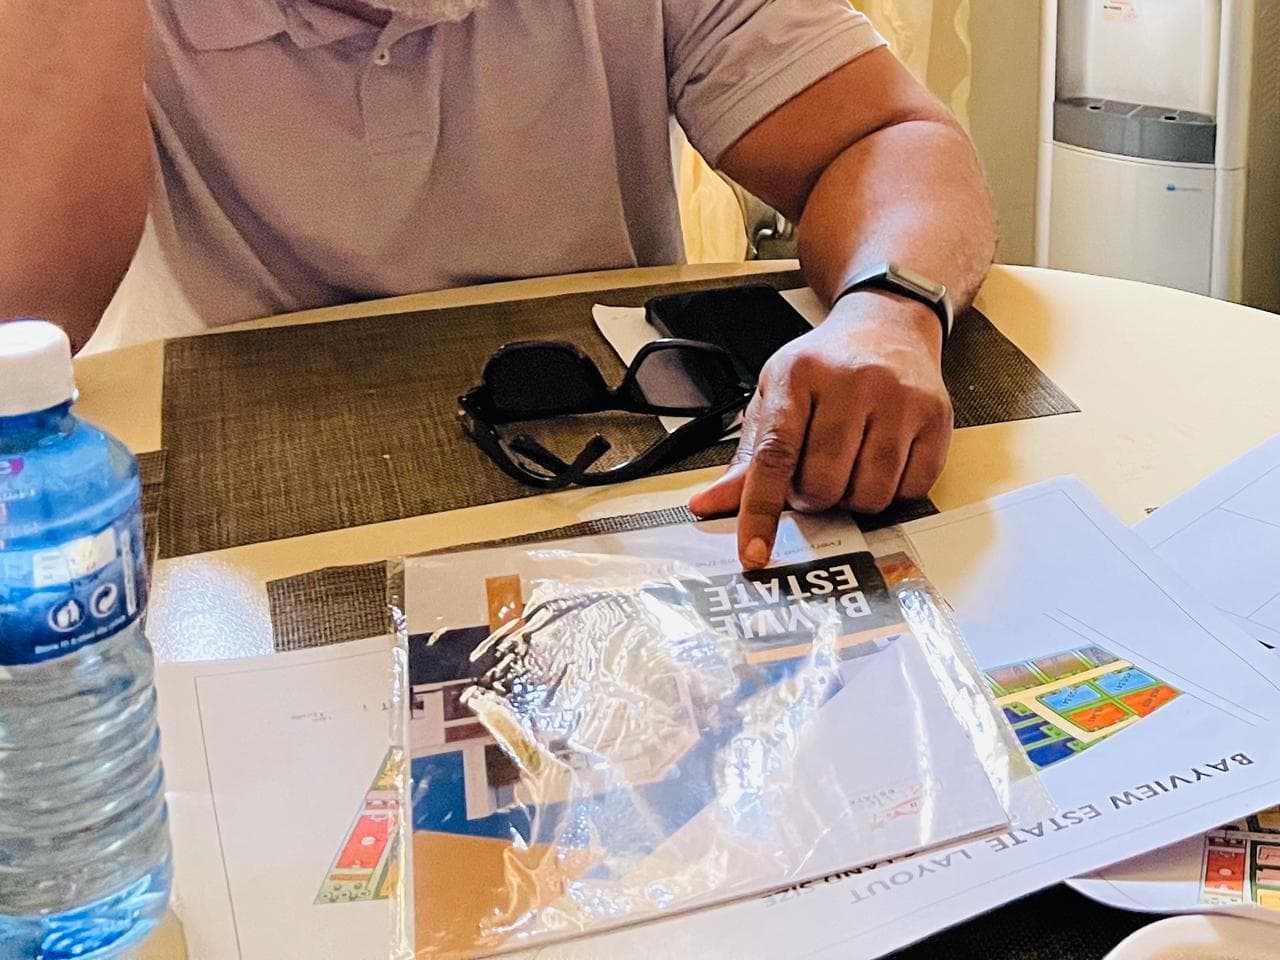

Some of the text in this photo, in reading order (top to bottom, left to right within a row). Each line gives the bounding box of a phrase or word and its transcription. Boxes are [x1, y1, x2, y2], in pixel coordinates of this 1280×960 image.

[703, 564, 860, 613] ESTATE
[849, 752, 1254, 905] BAYVIEW ESTATE LAYOUT
